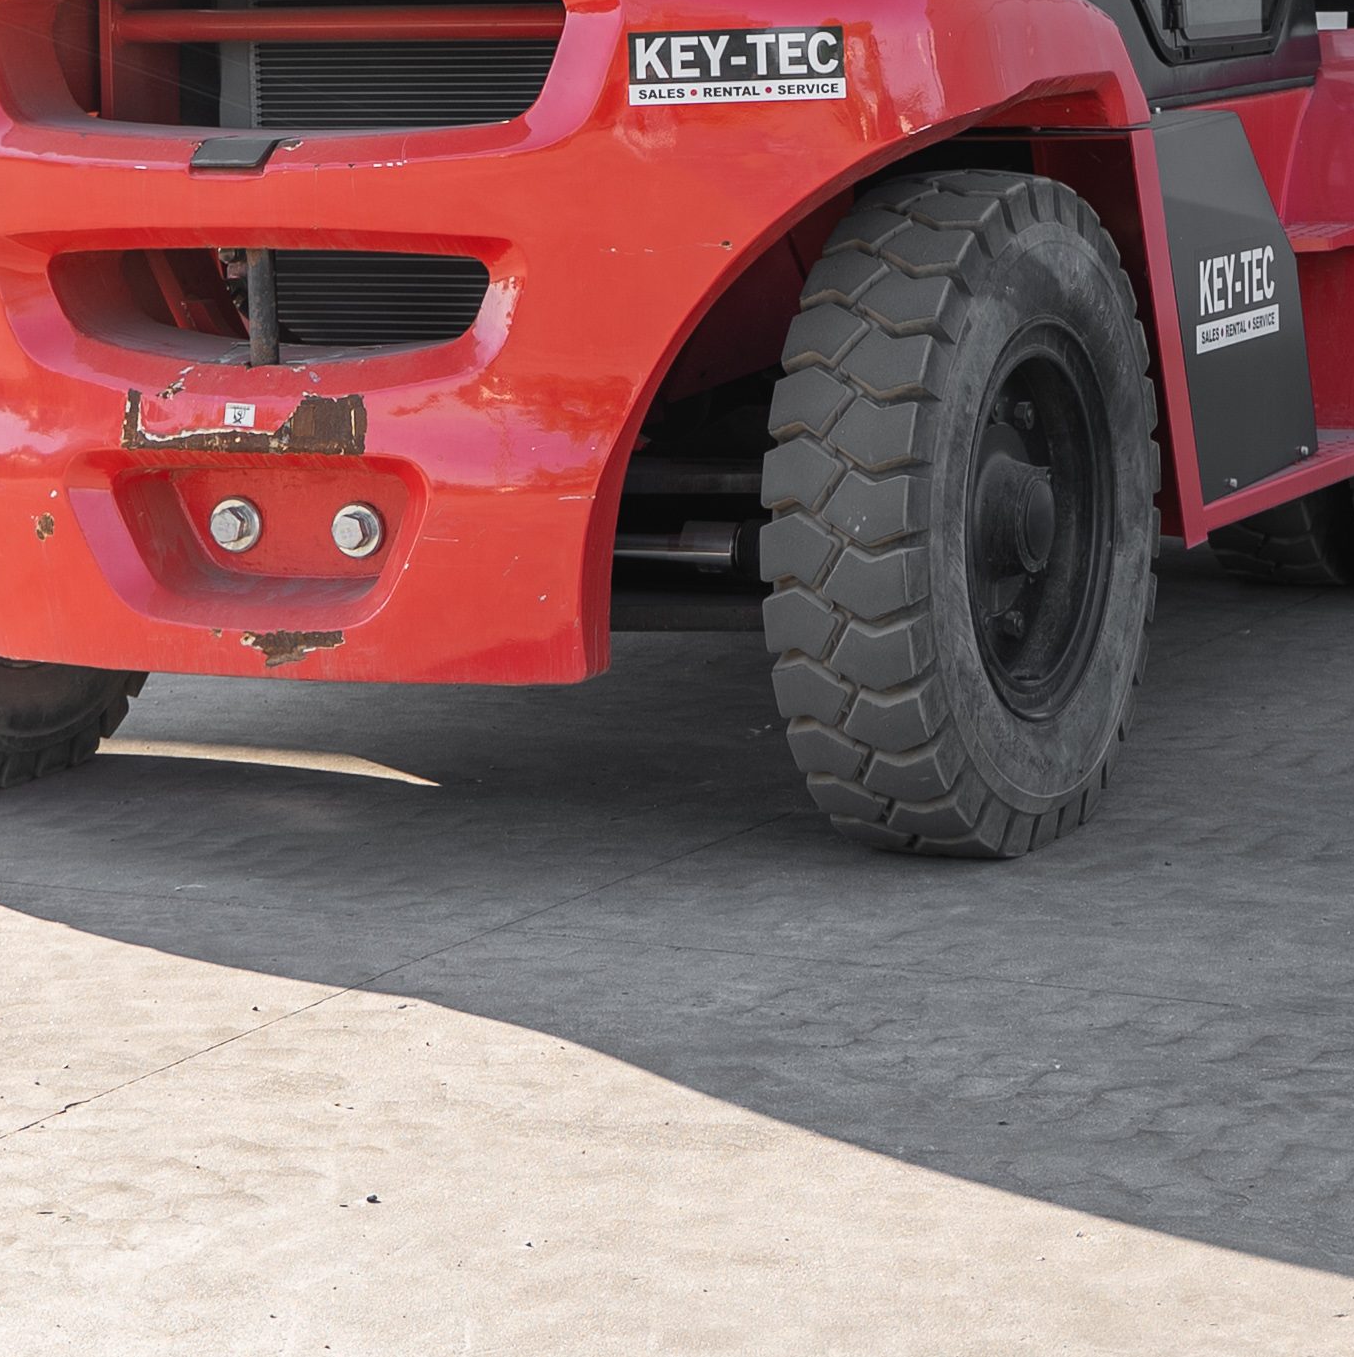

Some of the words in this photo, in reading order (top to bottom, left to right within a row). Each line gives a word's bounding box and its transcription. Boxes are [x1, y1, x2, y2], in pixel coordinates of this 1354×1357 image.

[634, 31, 839, 80] KEY-TEC
[638, 88, 685, 100] SALES
[702, 85, 761, 98] RENTAL
[777, 82, 840, 96] SERVICE
[1199, 245, 1275, 317] KEY-TEC
[1201, 327, 1220, 345] SALES
[1225, 319, 1247, 338] RENTAL
[1252, 311, 1275, 330] SERVICE
